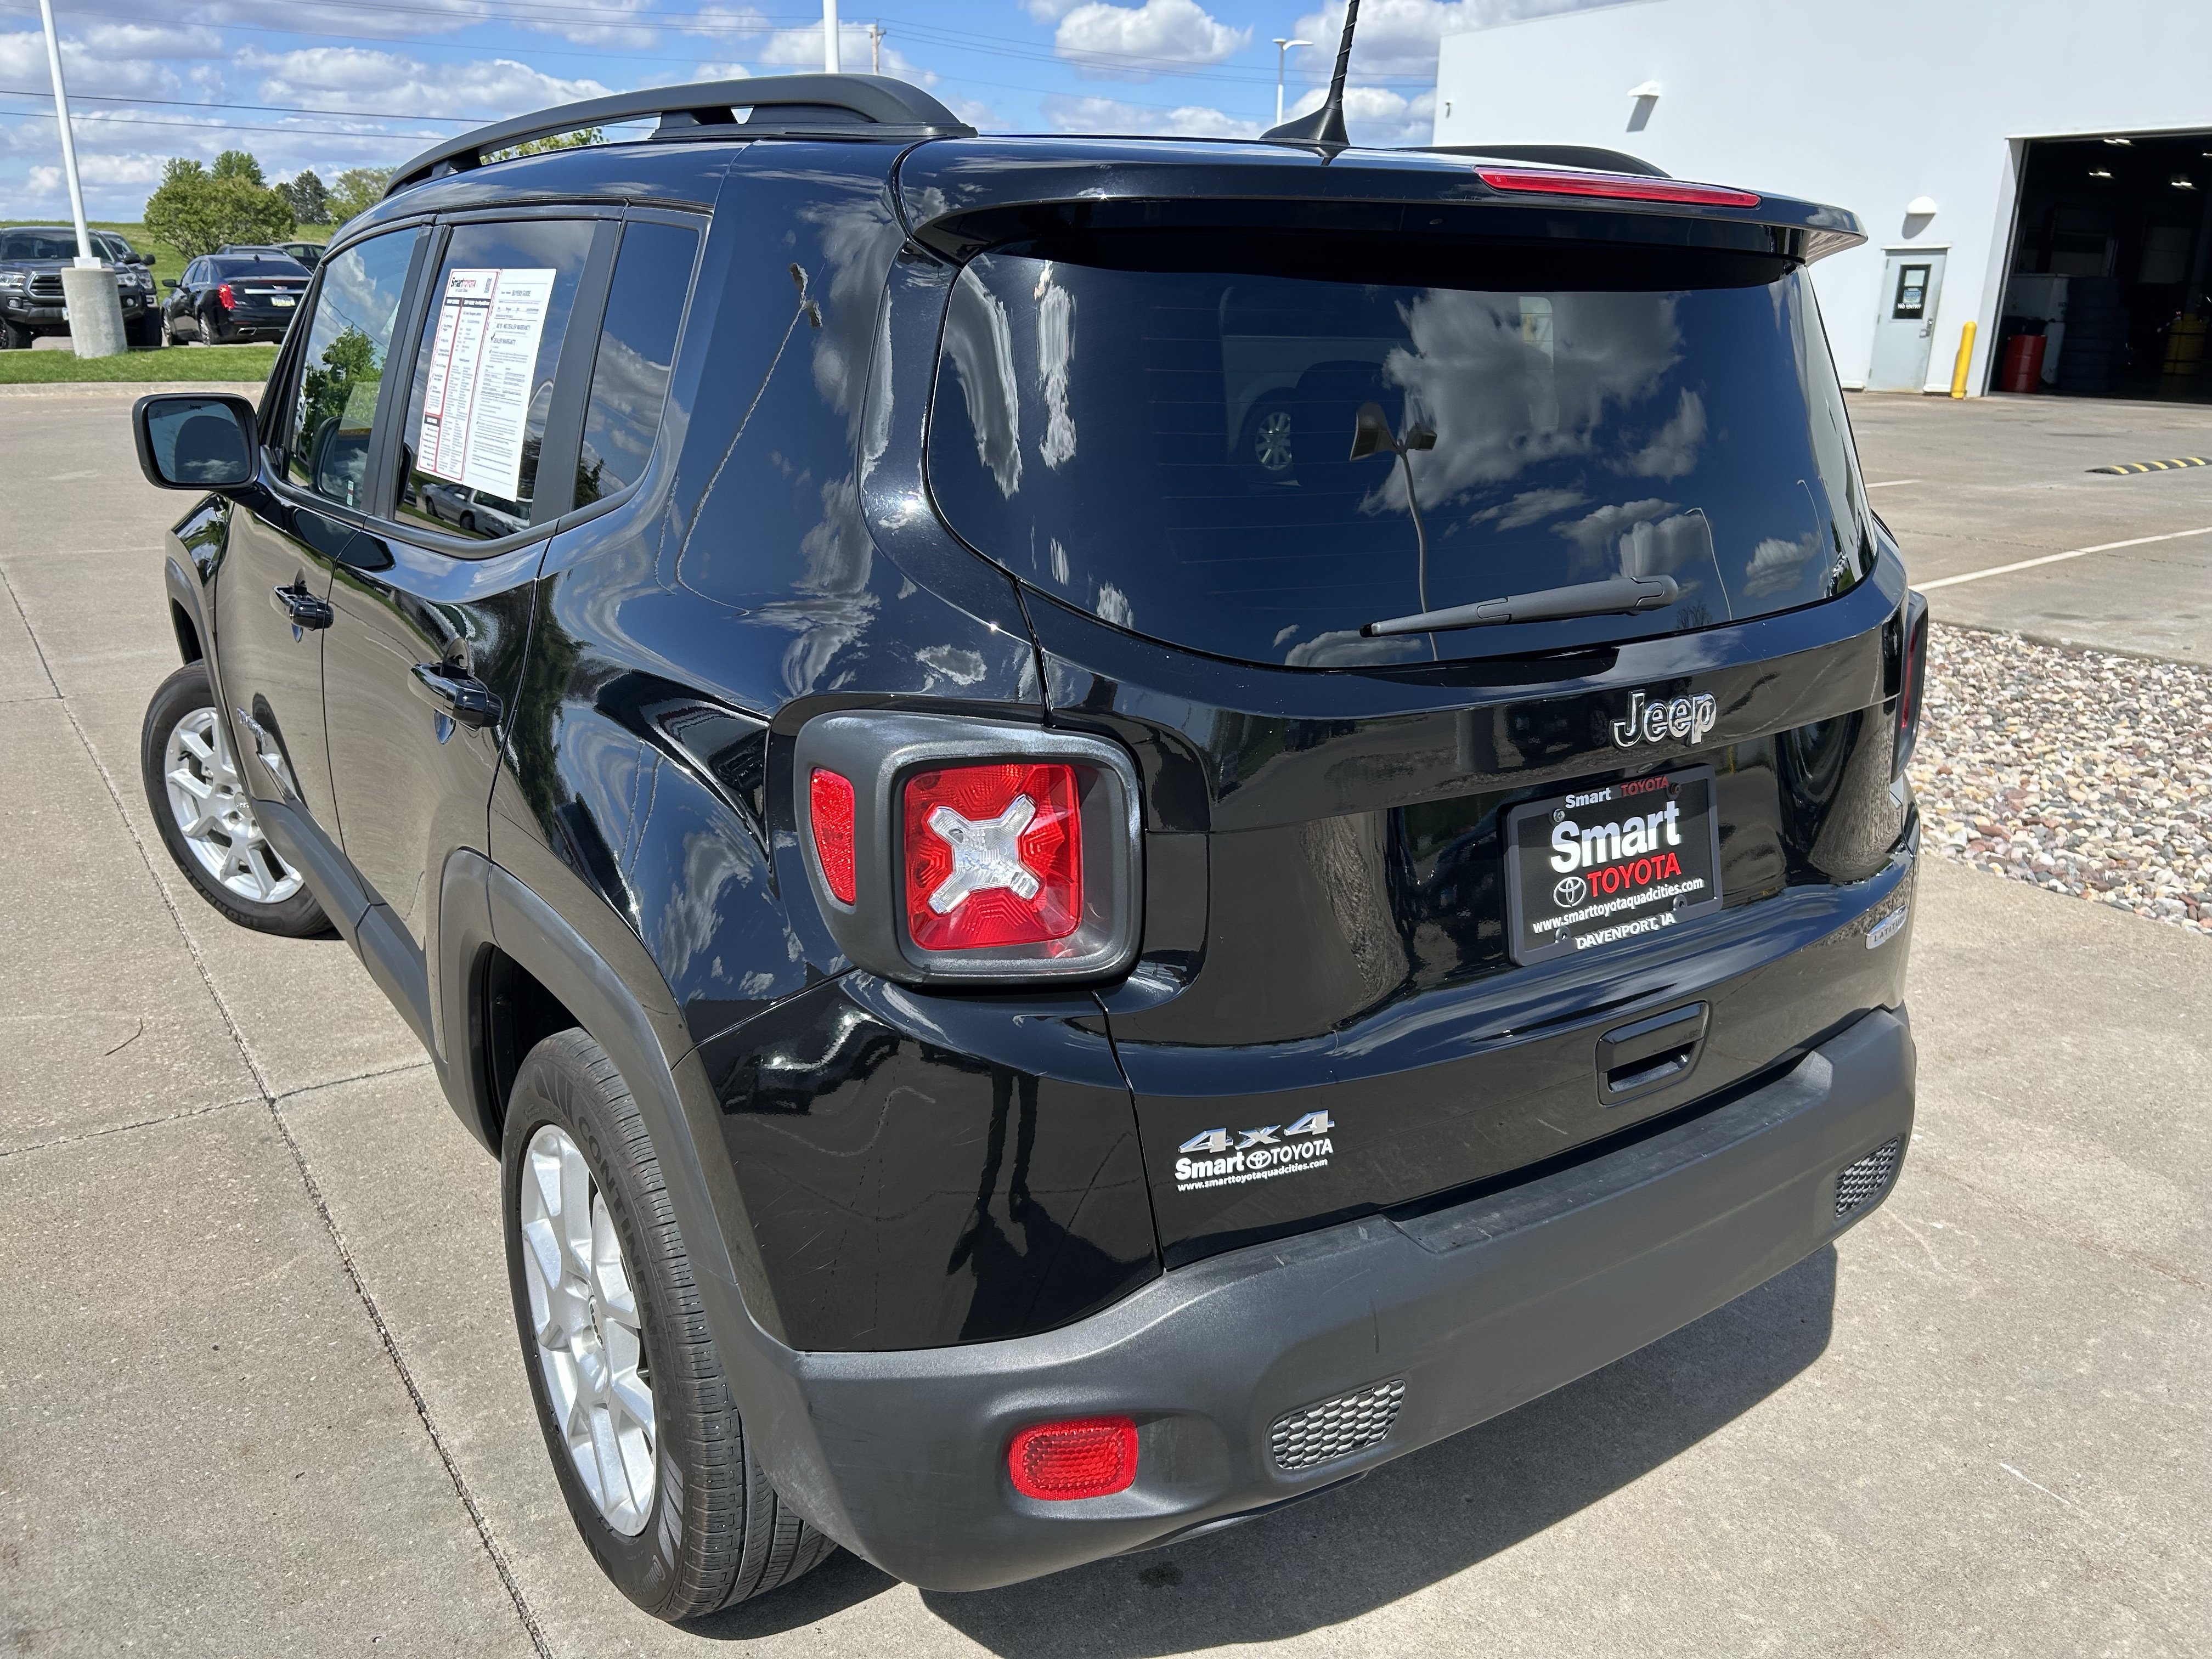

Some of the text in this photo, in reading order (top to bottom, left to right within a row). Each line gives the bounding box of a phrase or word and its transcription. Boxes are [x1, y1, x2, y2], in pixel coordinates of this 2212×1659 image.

[1610, 689, 1717, 749] Jeep
[1565, 776, 1669, 809] Smart TOYOTA
[1550, 800, 1681, 873] Smart
[1587, 851, 1682, 898] TOYOTA
[1532, 877, 1704, 934] www.smarttoyotaquadcities.com
[1576, 912, 1677, 950] DAVENPORT, IA
[1177, 1109, 1335, 1153] 4x4
[1175, 1138, 1334, 1181] Smart TOYOTA
[1177, 1158, 1328, 1192] www.smarttoyotaquadcities.com
